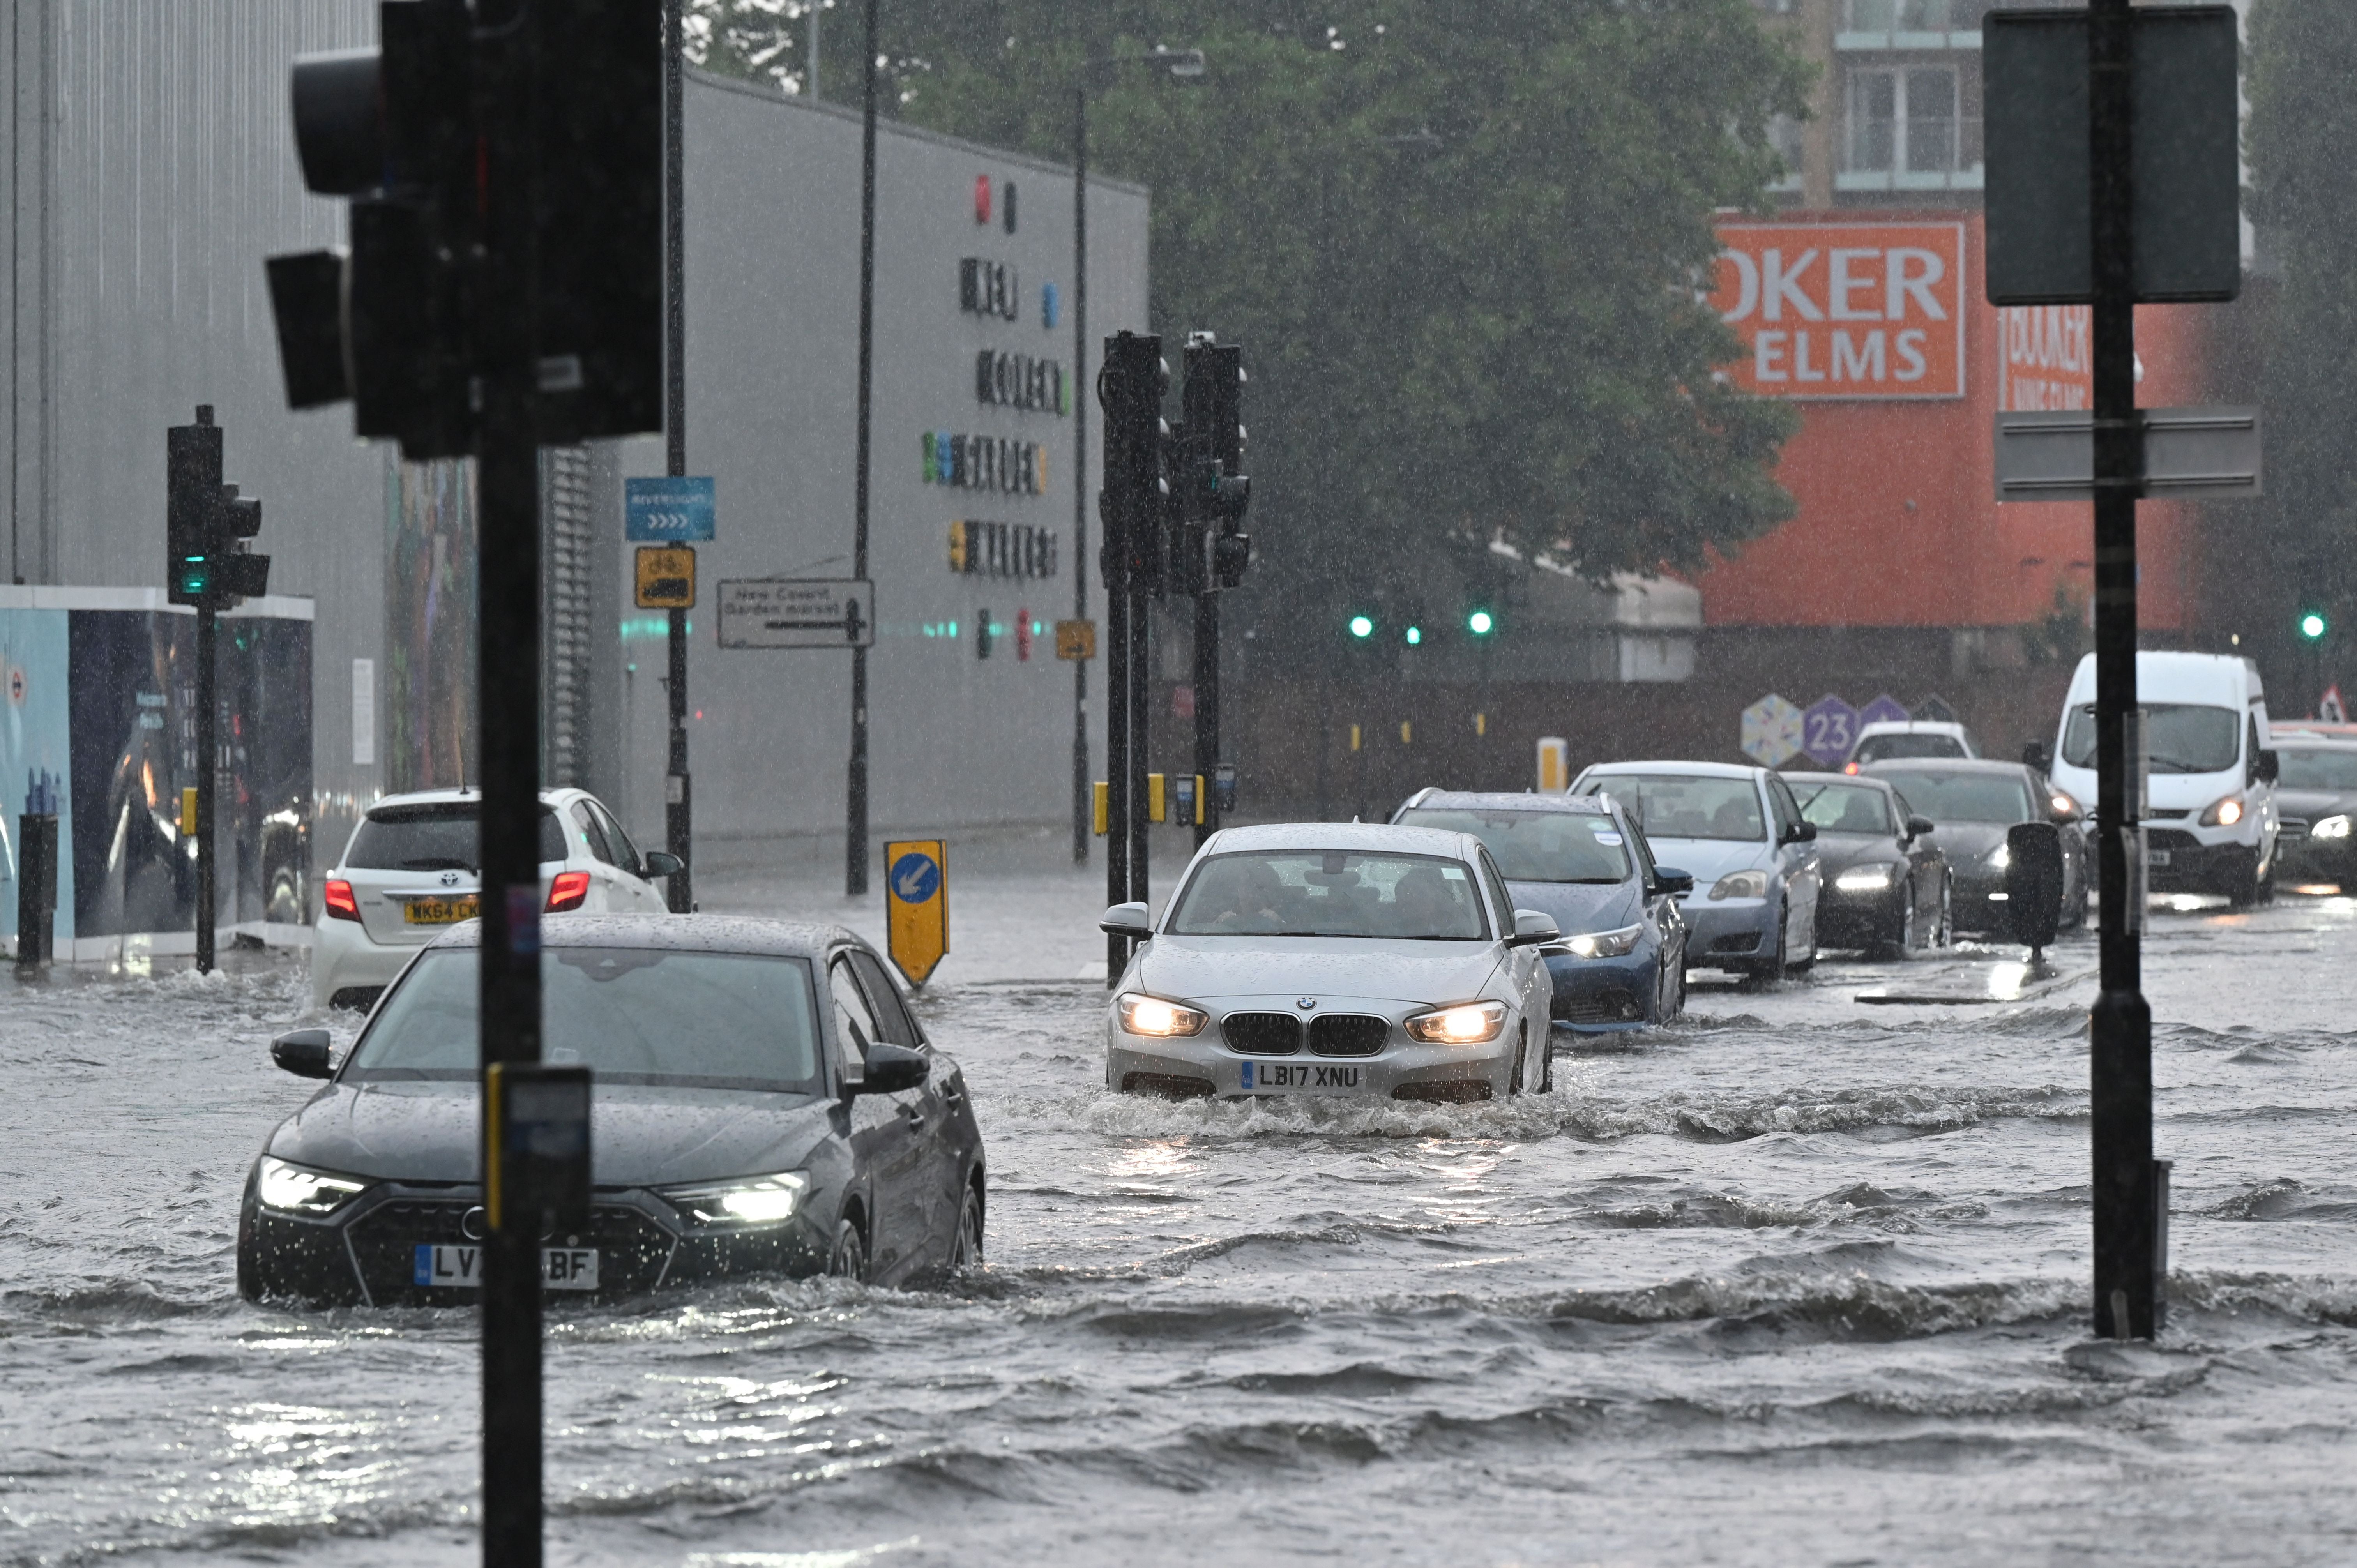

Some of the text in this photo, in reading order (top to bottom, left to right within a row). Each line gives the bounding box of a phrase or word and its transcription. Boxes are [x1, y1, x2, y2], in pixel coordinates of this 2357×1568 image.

[1713, 247, 1948, 322] OKER
[1756, 328, 1927, 382] ELMS
[1809, 713, 1850, 750] 23
[458, 901, 480, 918] CK
[1260, 1065, 1358, 1087] LB17 XNU
[543, 1251, 589, 1281] BF
